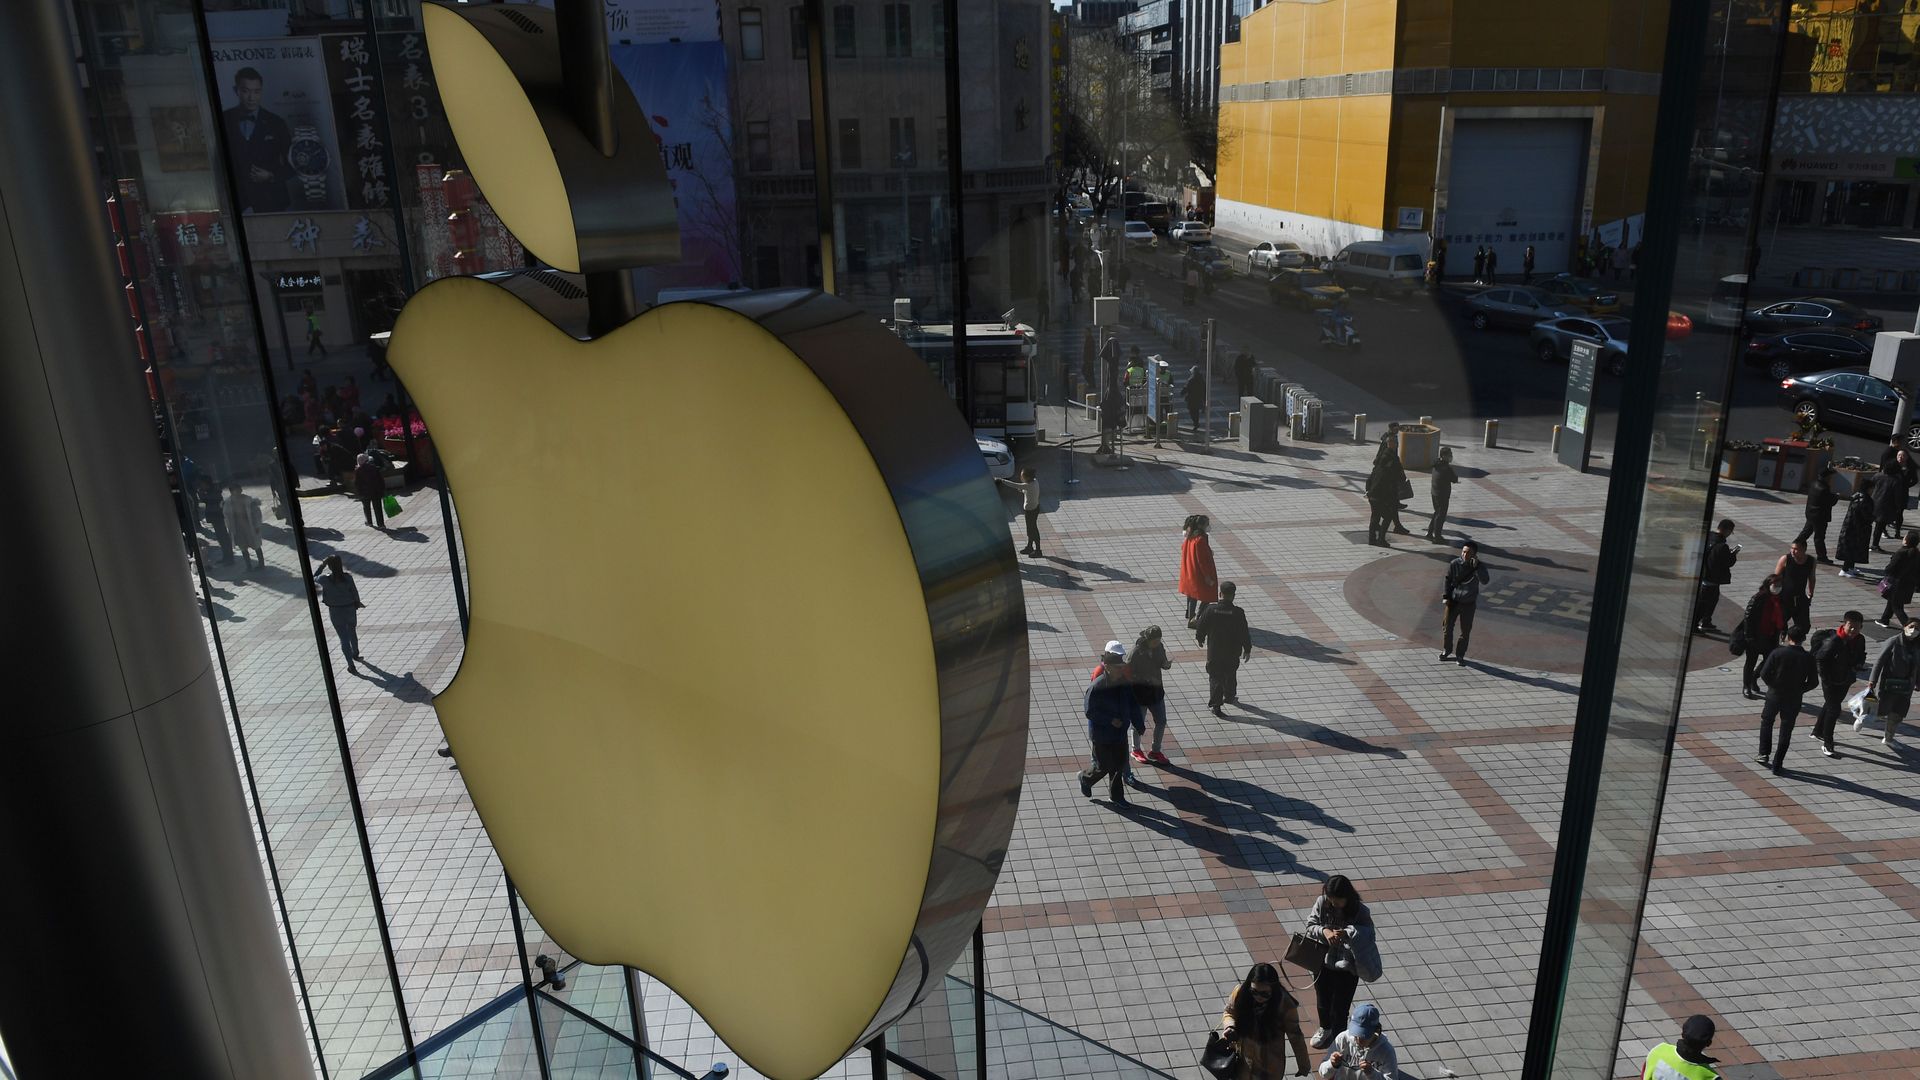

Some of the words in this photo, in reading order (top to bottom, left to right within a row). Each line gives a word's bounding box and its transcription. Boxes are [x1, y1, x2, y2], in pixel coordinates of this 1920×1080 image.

[606, 9, 629, 31] 你
[339, 36, 391, 207] 瑞士名表维修
[1799, 161, 1838, 171] HUAWEI
